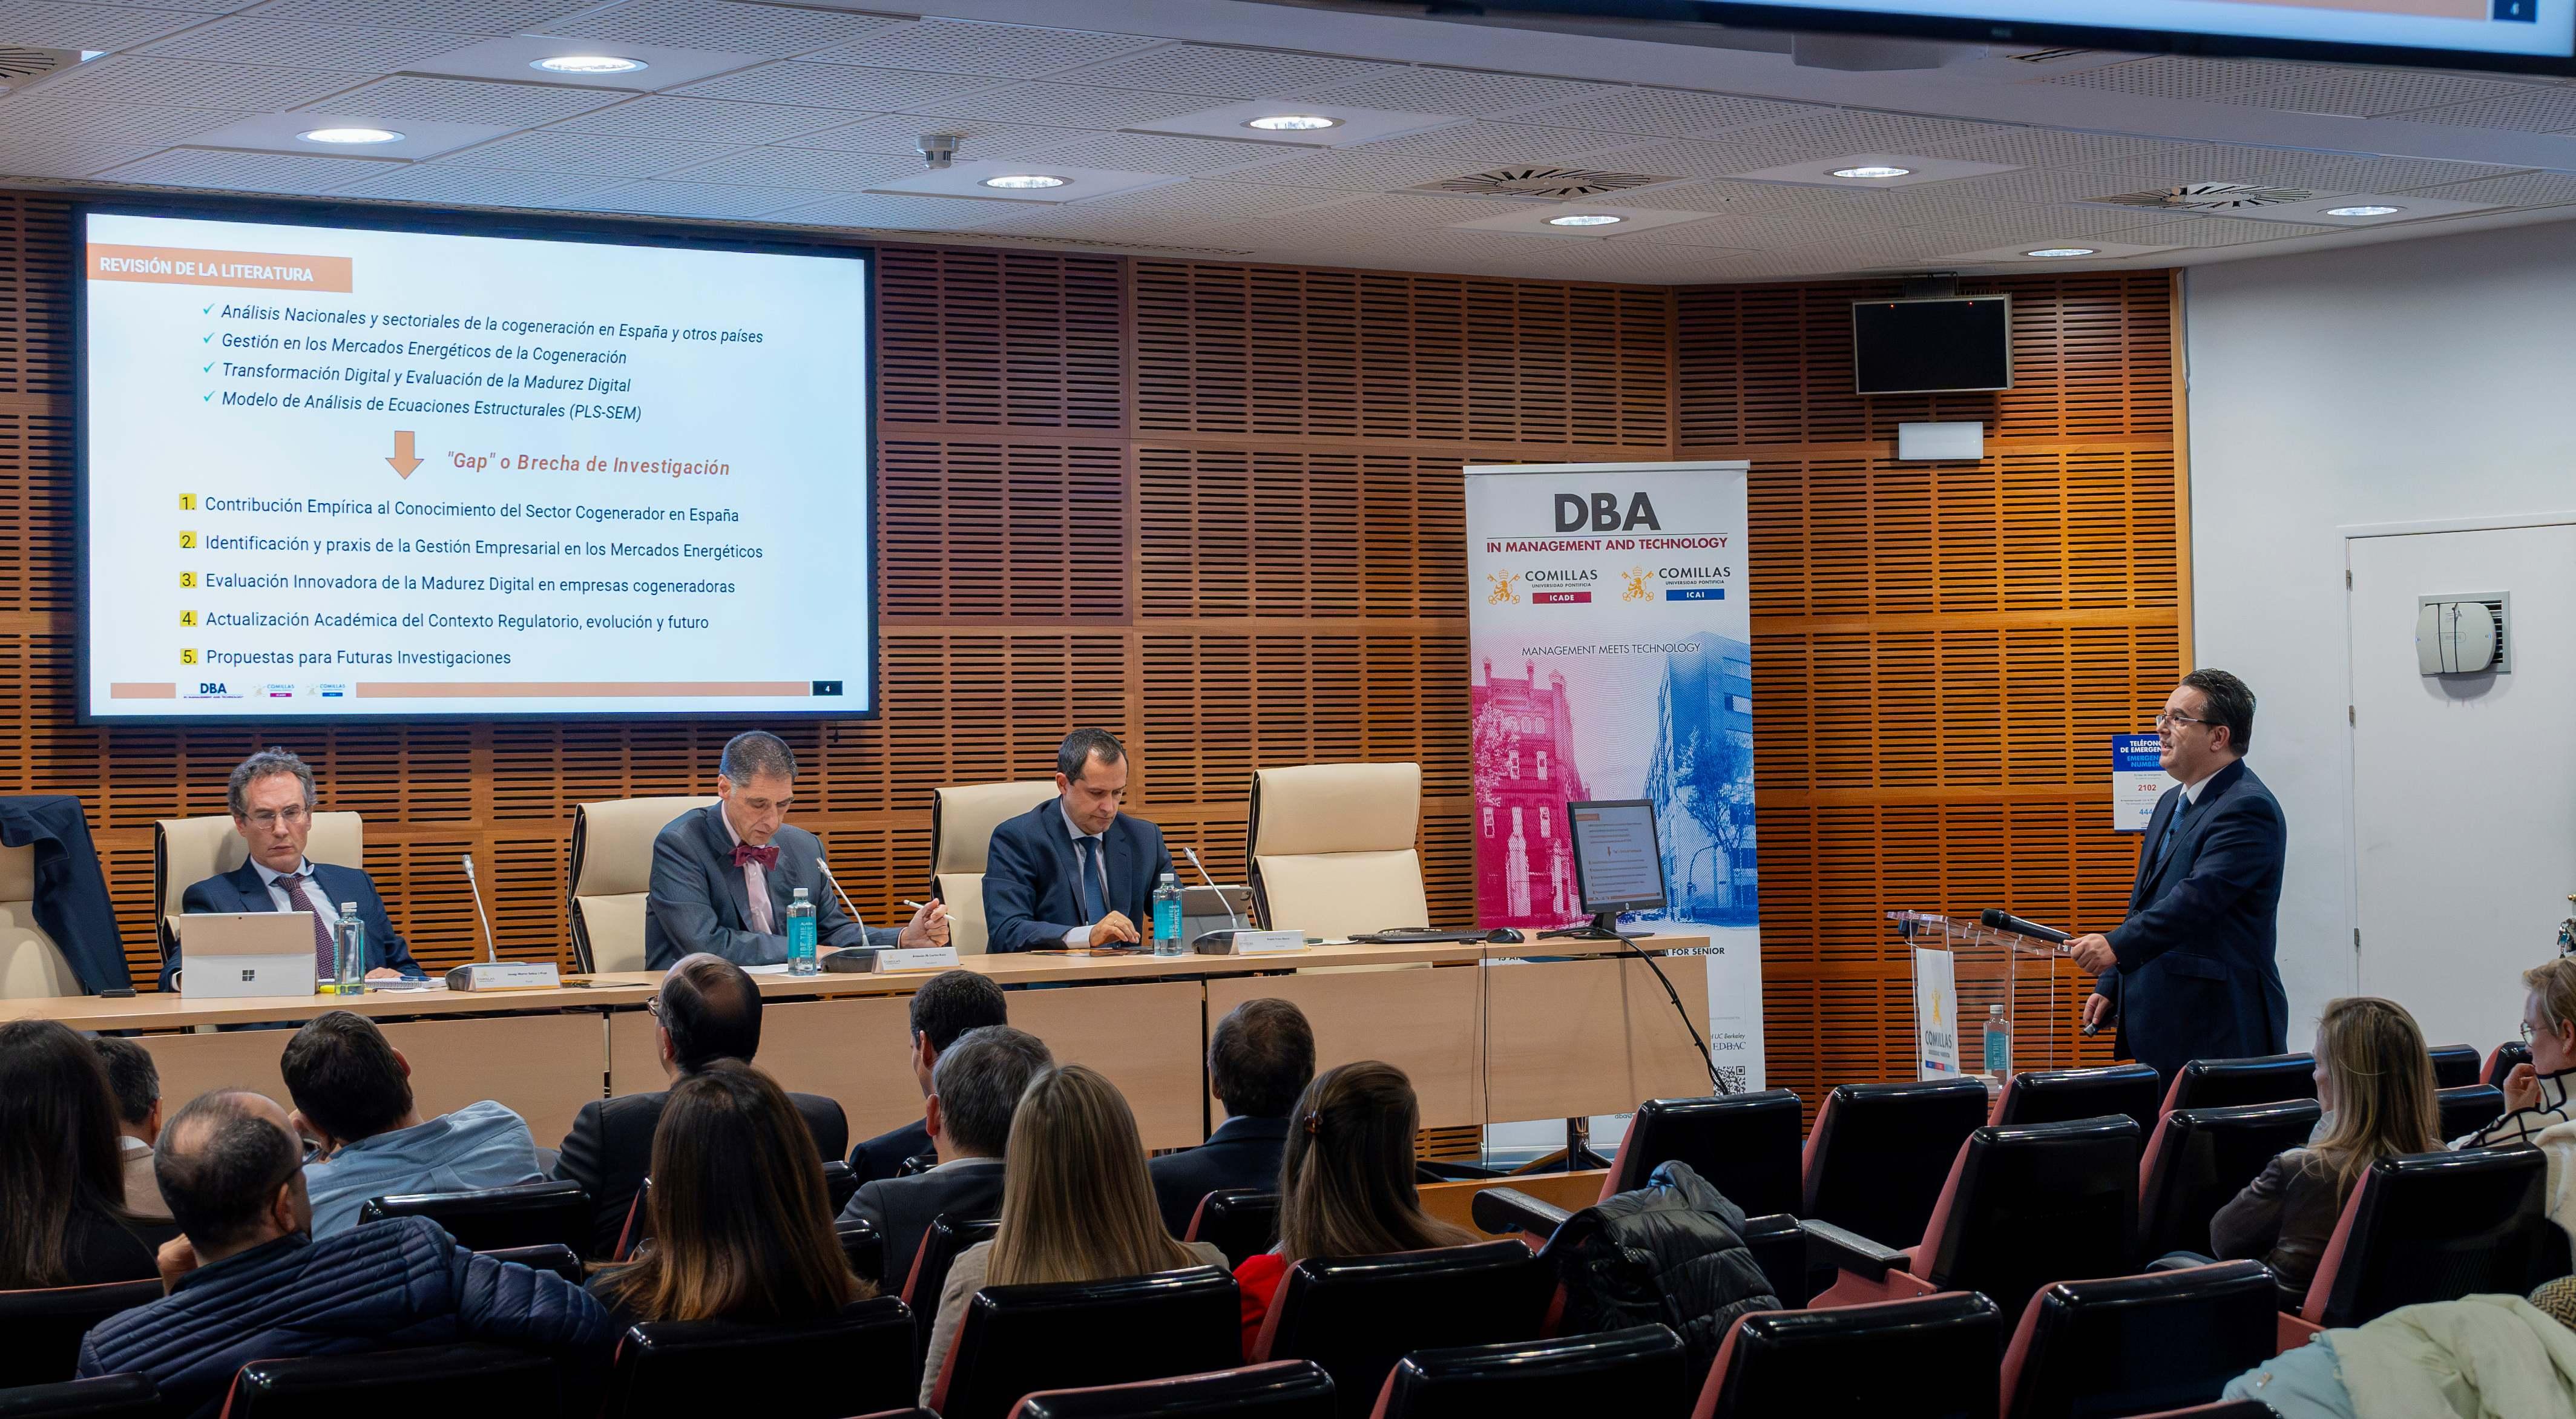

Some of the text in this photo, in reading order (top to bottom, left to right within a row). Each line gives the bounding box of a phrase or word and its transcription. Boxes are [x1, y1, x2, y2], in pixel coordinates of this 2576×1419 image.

[100, 257, 314, 281] REVISIÓN DE LA LITERATURA
[220, 304, 763, 345] Análisis Nacionales y sectoriales de la cogeneración en España y otros países
[222, 333, 627, 365] Gestión en los Mercados Energéticos de la Cogeneración
[223, 362, 631, 395] Transformación Digital y Evaluación de la Madurez Digital
[222, 391, 642, 423] Modelo de Análisis de Ecuaciones Estructurales (PLS-SEM)
[448, 450, 730, 479] "Gap" o Brecha de Investigación
[182, 496, 739, 525] 1. Contribución Empírica al Conocimiento del Sector Cogenerador en España
[1554, 492, 1661, 533] DBA
[182, 535, 763, 561] 2. Identificación y praxis de la Gestión Empresarial en los Mercados Energéticos
[1487, 537, 1728, 553] IN MANAGEMENT AND TECHNOLOGY
[1525, 569, 1598, 582] COMILLAS
[1658, 566, 1730, 579] COMILLAS
[182, 573, 735, 596] 3. Evaluación Innovadora de la Madurez Digital en empresas cogeneradoras
[182, 611, 709, 632] 4. Actualización Académica del Contexto Regulatorio, evolución y futuro
[183, 650, 511, 668] 5. Propuestas para Futuras Investigaciones
[1522, 642, 1701, 656] MANAGEMENT MEETS TECHNOLOGY
[200, 683, 227, 694] DBA
[1713, 1041, 1746, 1050] EDBAC
[1925, 1030, 1952, 1049] COMILLAS
